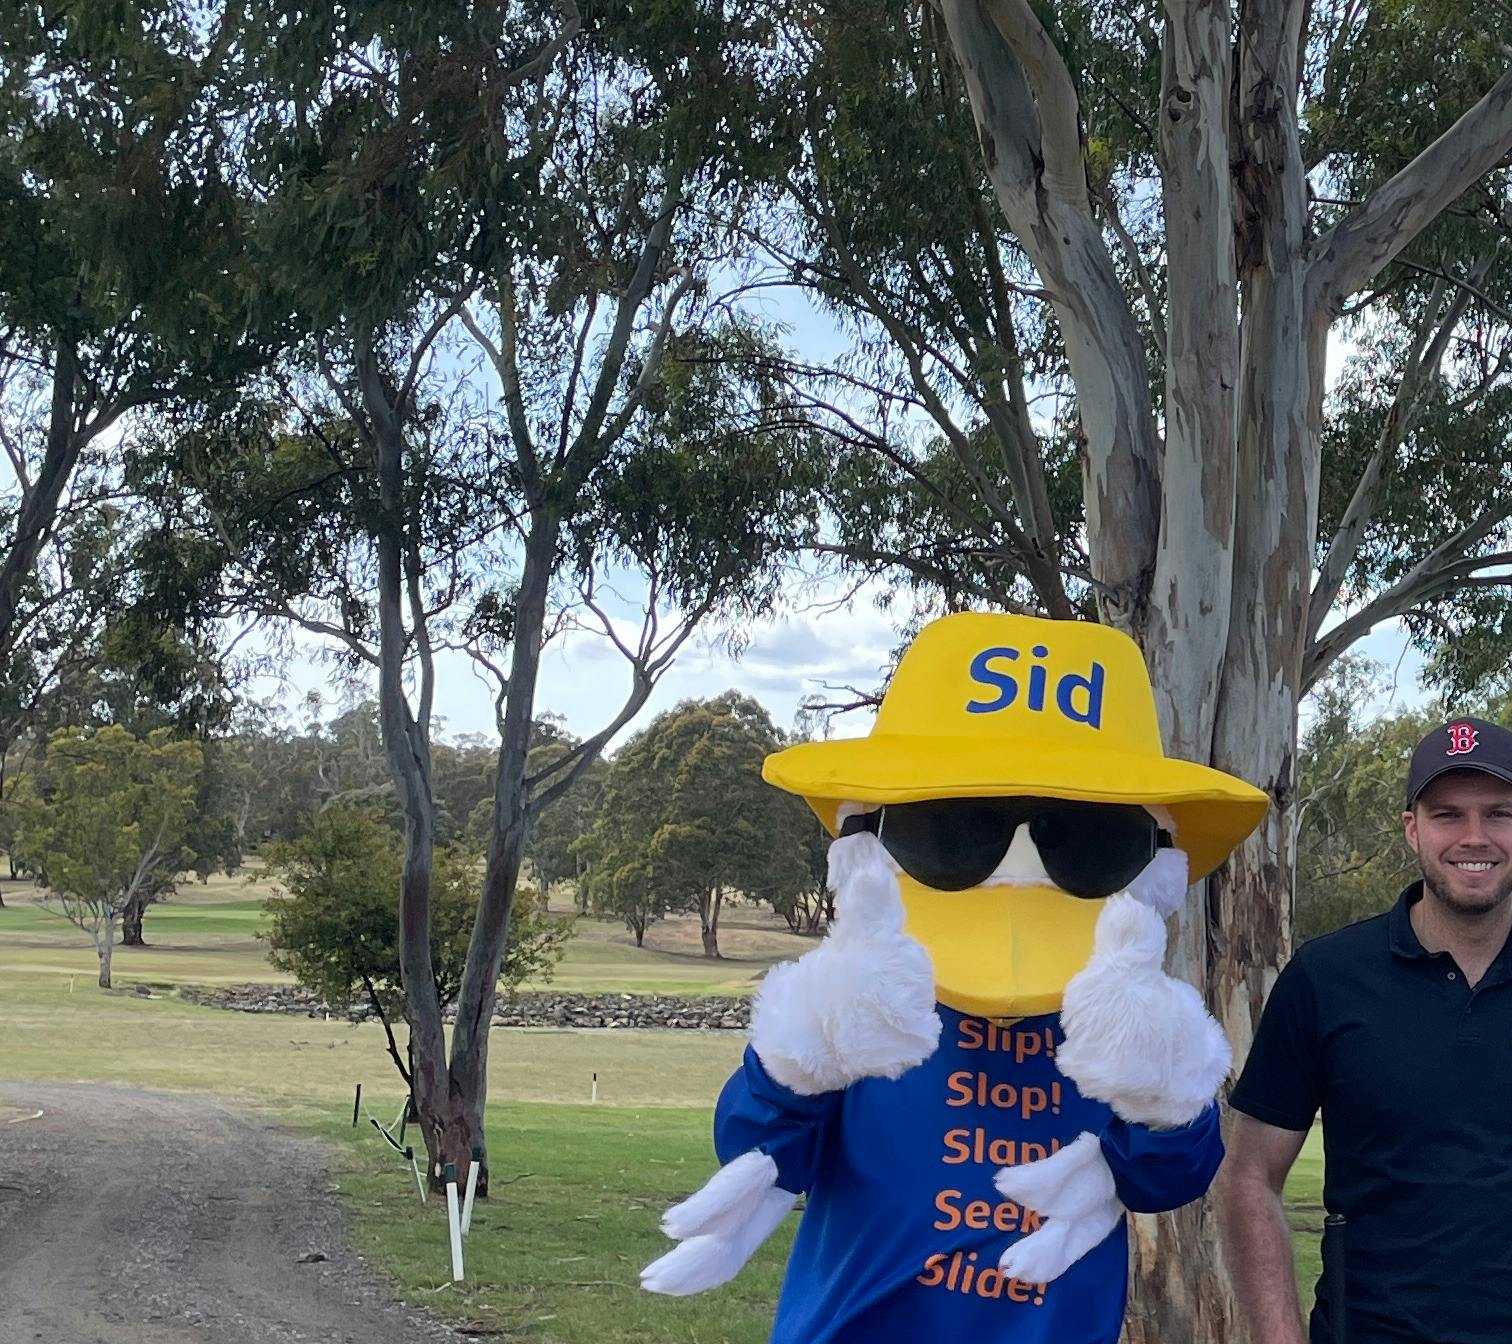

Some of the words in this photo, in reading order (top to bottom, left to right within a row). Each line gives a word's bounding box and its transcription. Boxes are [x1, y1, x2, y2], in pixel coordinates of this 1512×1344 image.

[965, 644, 1105, 731] Sid
[1446, 723, 1480, 756] B
[957, 1019, 1056, 1064] Slip!
[946, 1071, 1062, 1120] Slop!
